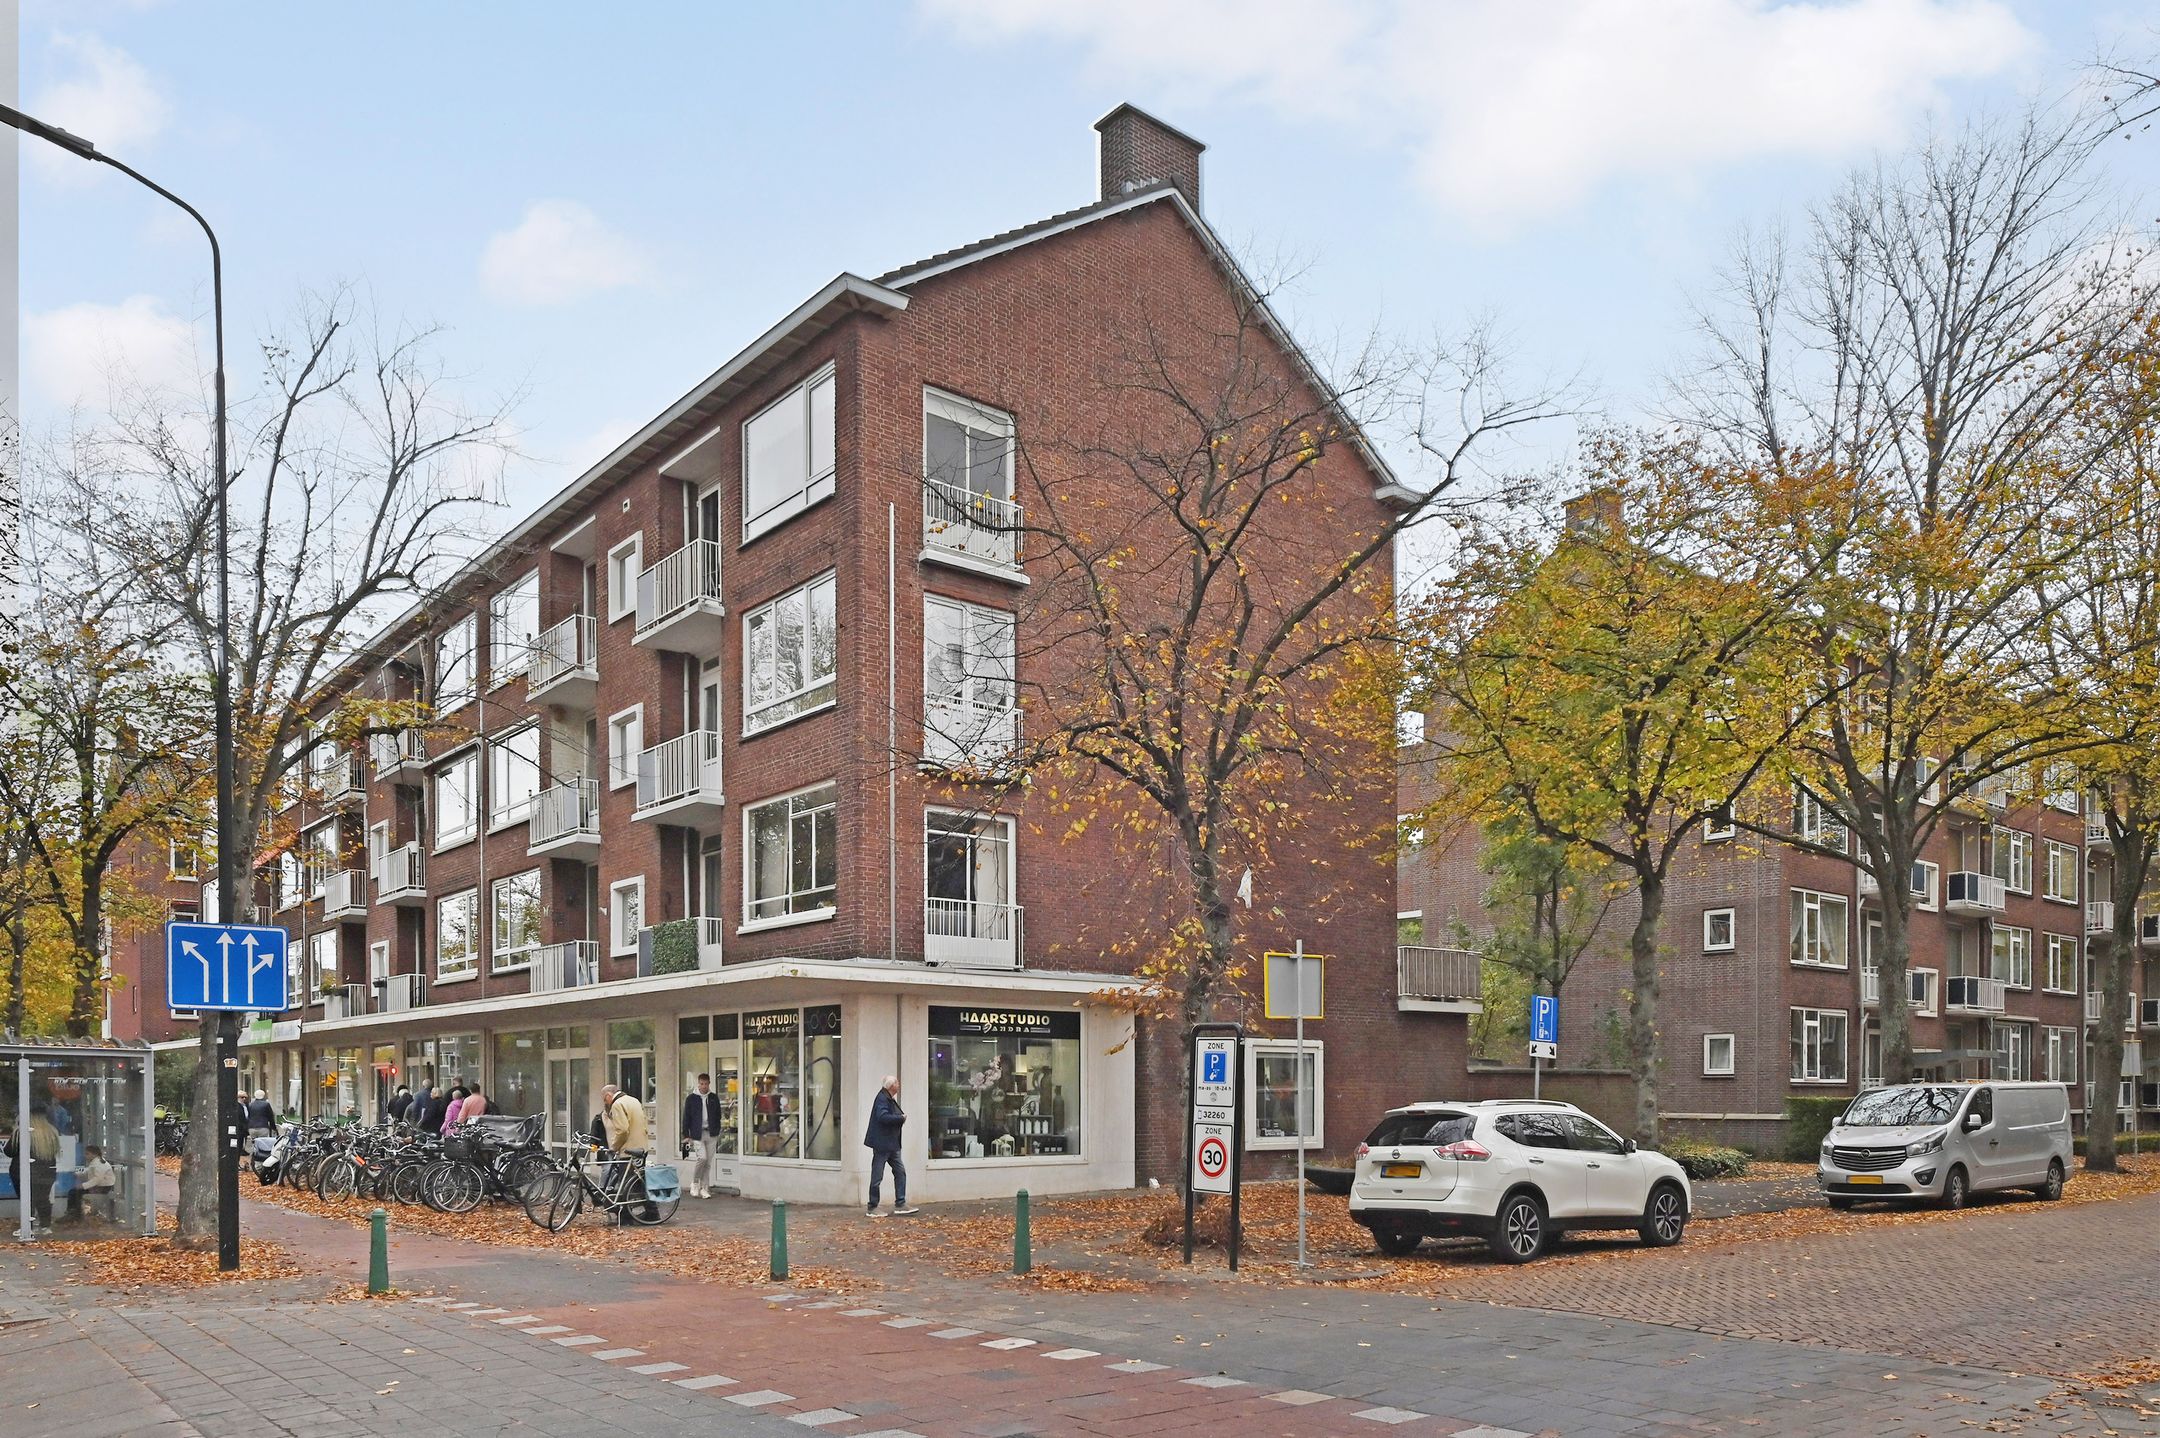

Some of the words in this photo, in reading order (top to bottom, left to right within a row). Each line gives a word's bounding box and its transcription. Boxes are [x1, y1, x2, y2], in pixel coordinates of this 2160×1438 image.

[1539, 1000, 1550, 1021] P
[745, 1014, 799, 1026] HAARSTUDIO
[960, 1012, 1050, 1025] HAARSTUDIO
[982, 1022, 1030, 1033] SANDRA
[1211, 1054, 1219, 1069] P
[1203, 1111, 1225, 1119] 32260
[1203, 1150, 1222, 1165] 30
